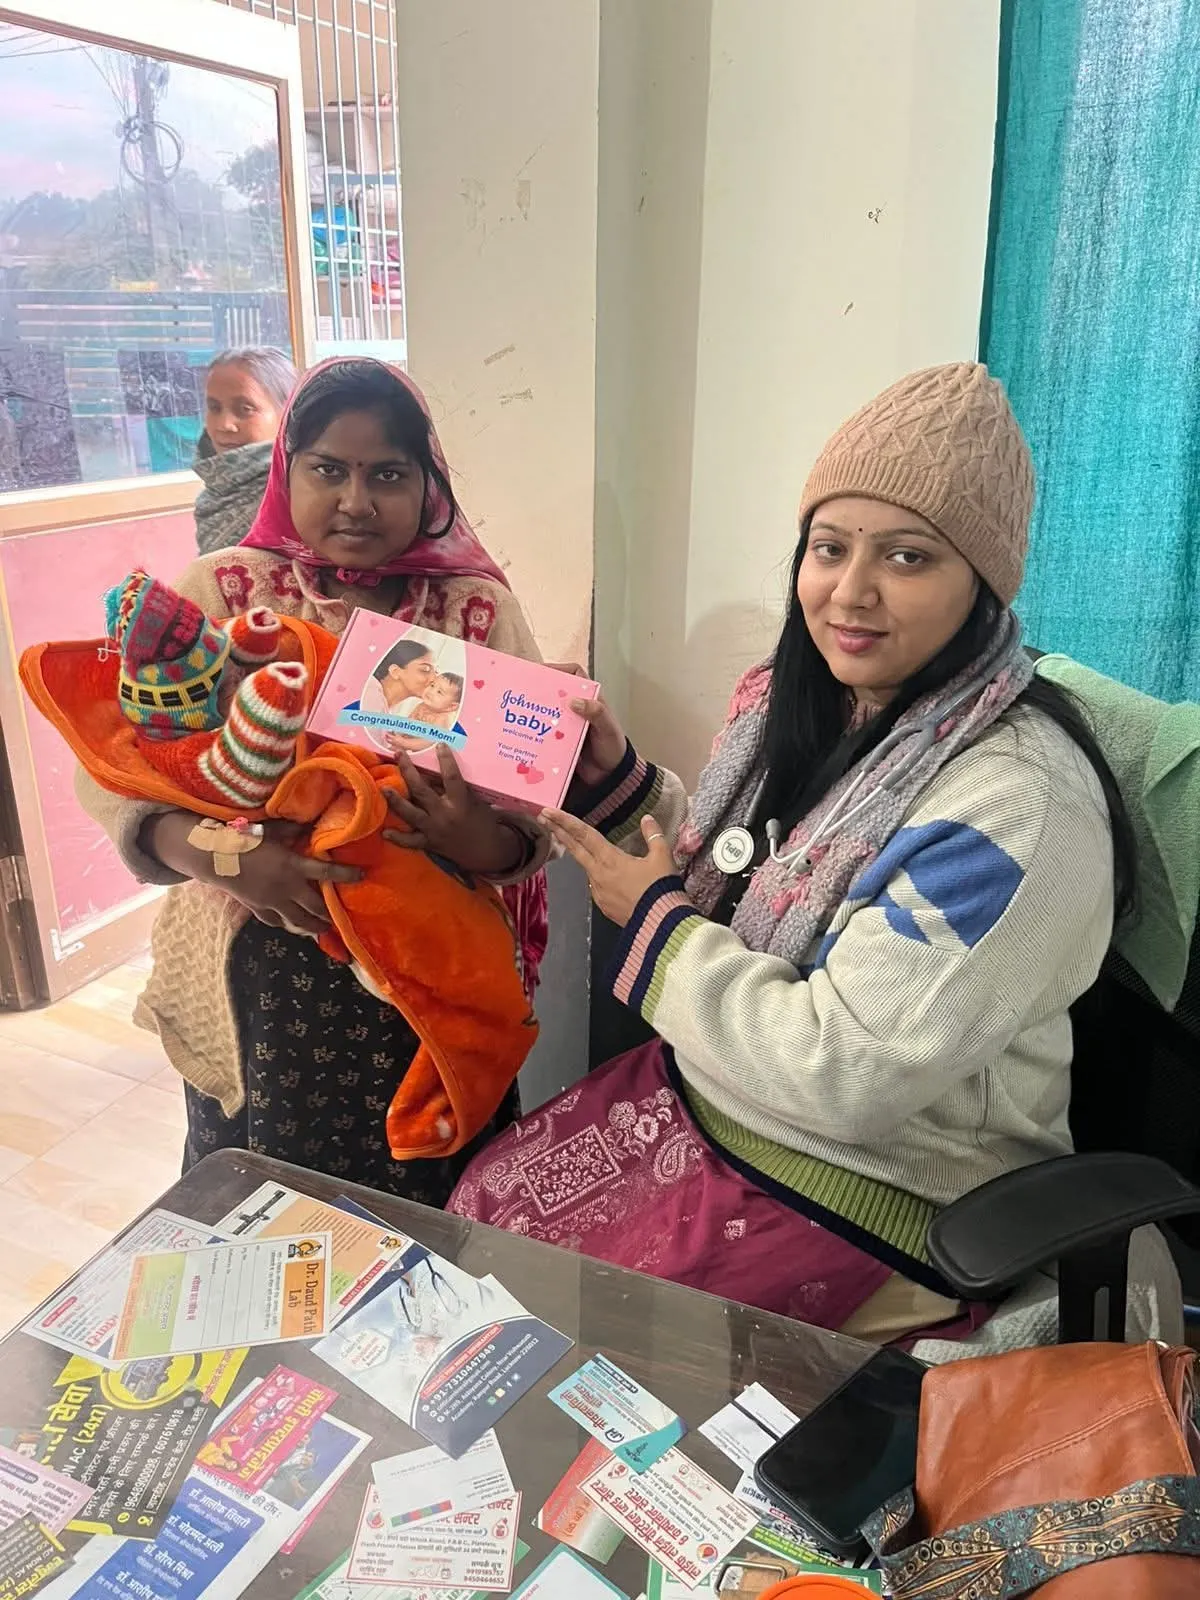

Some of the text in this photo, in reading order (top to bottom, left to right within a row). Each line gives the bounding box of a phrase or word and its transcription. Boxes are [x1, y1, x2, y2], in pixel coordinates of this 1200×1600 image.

[500, 689, 562, 719] Johnson's
[350, 713, 456, 743] Congratulations Mom!
[502, 726, 544, 744] welcome kit
[504, 709, 552, 737] baby
[498, 742, 538, 760] Your partner
[498, 750, 515, 763] from
[515, 754, 529, 766] Day
[288, 1289, 303, 1308] Lab
[301, 1263, 319, 1334] Dr. Daud Path
[46, 1383, 94, 1424] सेवा
[70, 1447, 86, 1464] AC
[103, 1452, 123, 1476] सभी
[114, 1429, 136, 1457] प्रकार
[586, 1476, 617, 1506] सेन्टर
[608, 1495, 631, 1517] ब्लड
[621, 1485, 651, 1513] सेन्टर
[187, 1485, 252, 1531] डॉ. आलोक तिवारी
[165, 1512, 226, 1556] डॉ. मोहम्मद अली
[621, 1508, 660, 1545] चैरिटेबल
[142, 1542, 196, 1582] डॉ. सौरभ मिश्रा
[650, 1533, 681, 1563] लाईन
[114, 1568, 131, 1585] डॉ.
[671, 1551, 704, 1583] लाईफ
